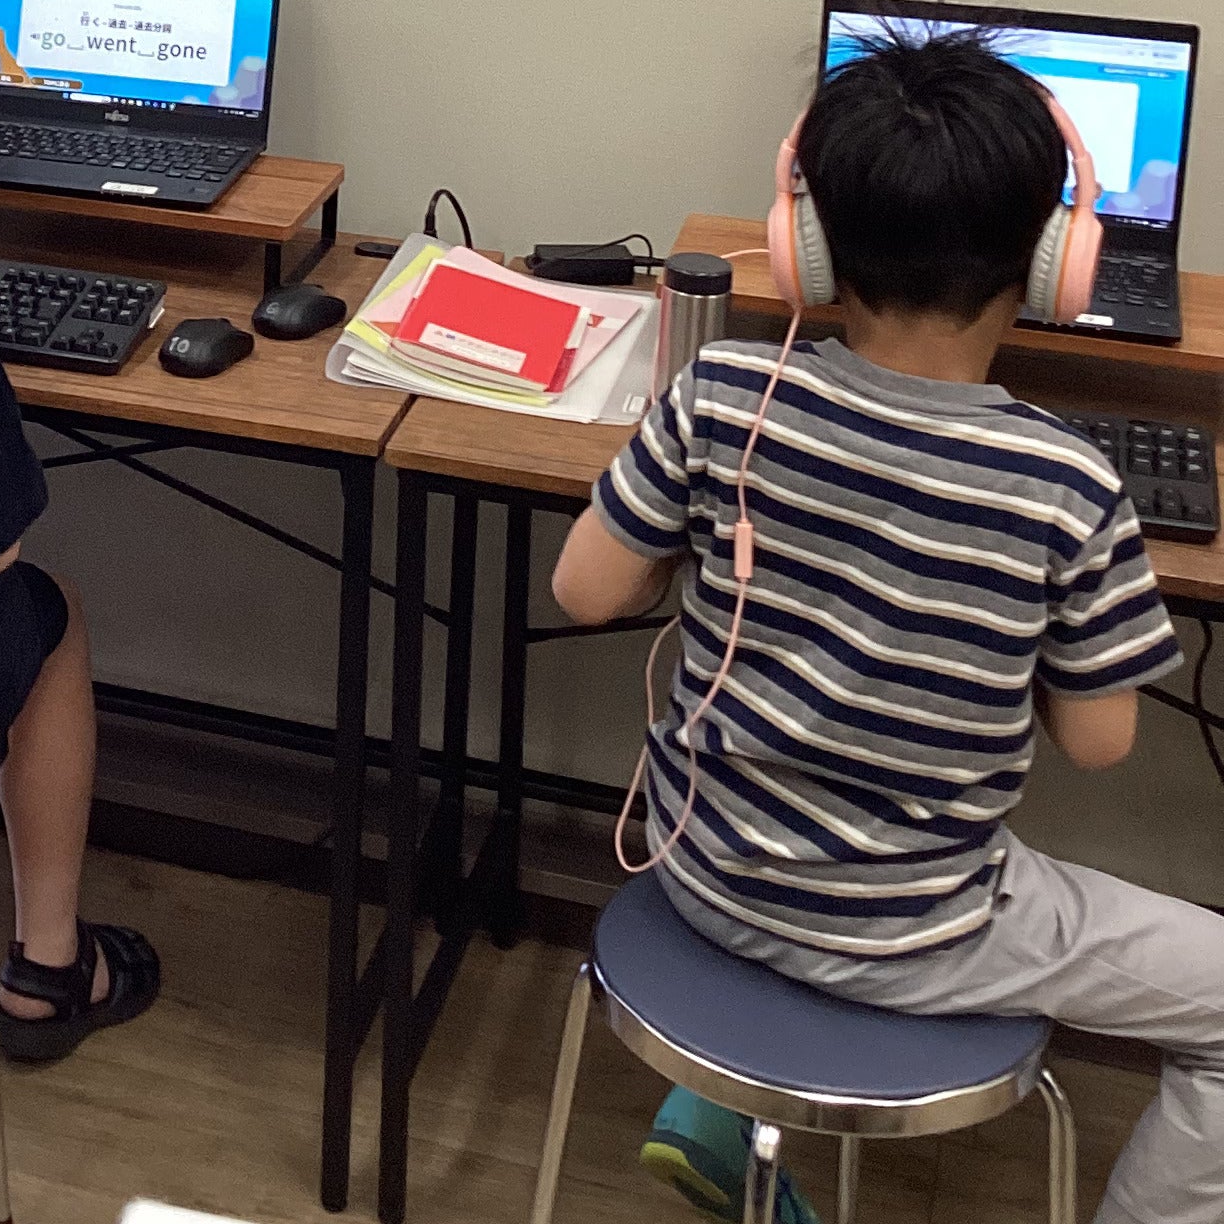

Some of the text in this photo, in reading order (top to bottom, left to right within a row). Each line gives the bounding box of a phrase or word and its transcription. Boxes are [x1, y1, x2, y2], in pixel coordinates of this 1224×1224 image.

[87, 36, 137, 54] went
[156, 42, 207, 61] gone
[169, 337, 190, 353] 10
